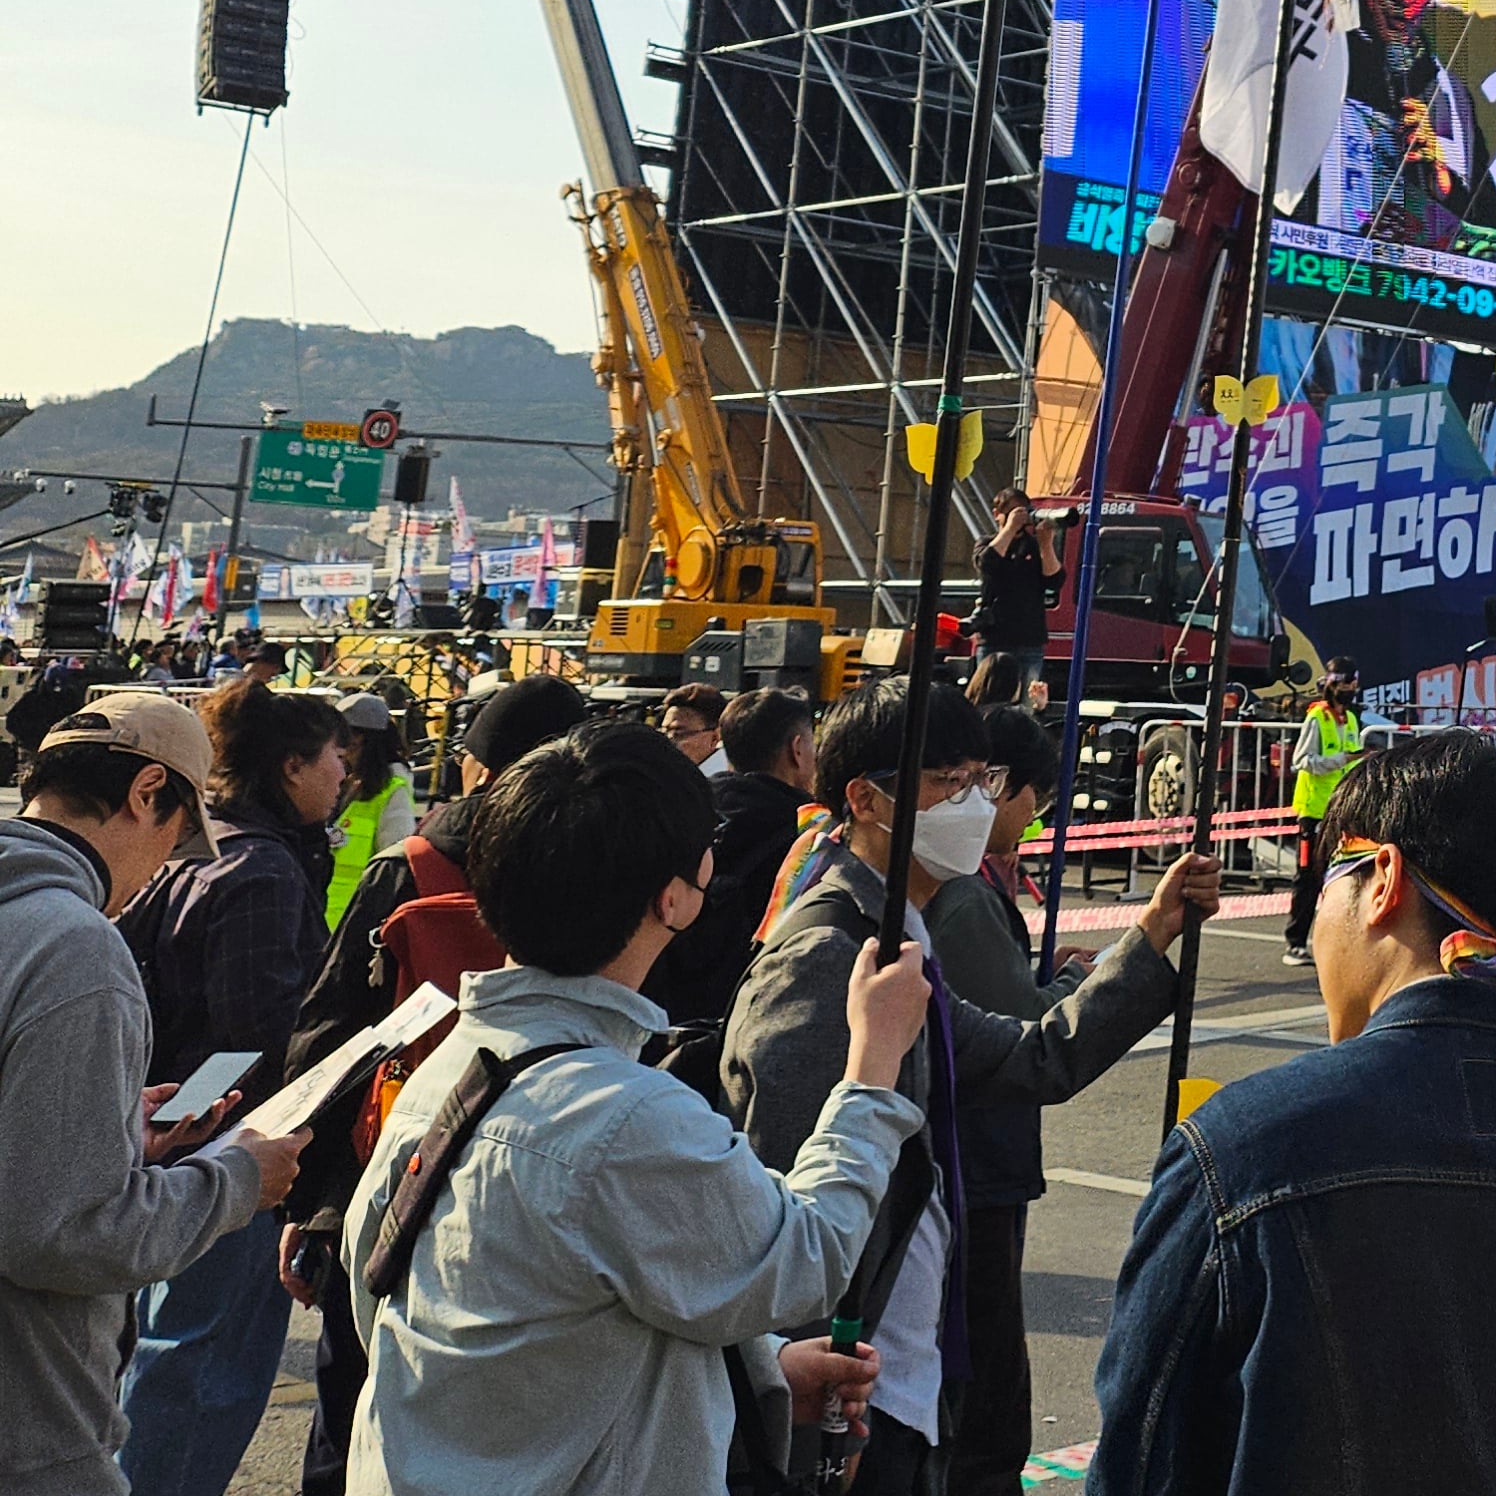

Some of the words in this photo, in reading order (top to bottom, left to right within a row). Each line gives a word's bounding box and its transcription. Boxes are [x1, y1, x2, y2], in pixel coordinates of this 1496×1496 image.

[1267, 248, 1373, 297] 카오뱅크
[369, 422, 391, 439] 40
[1320, 391, 1447, 493] 즉각
